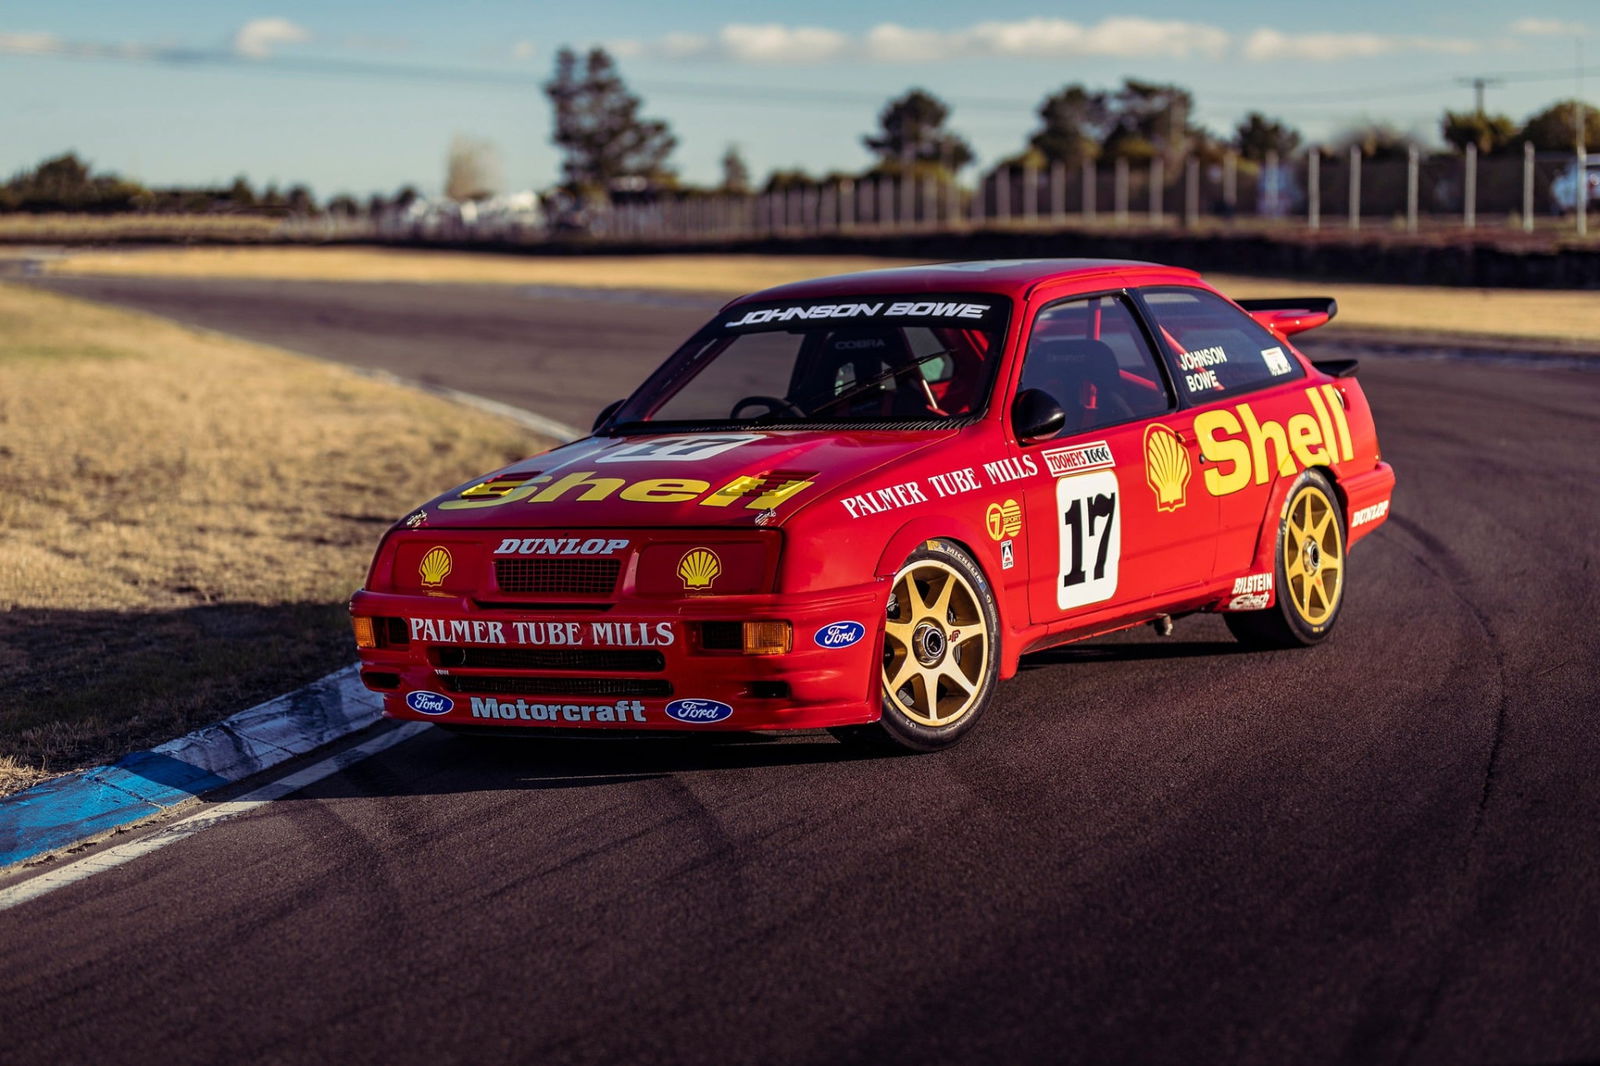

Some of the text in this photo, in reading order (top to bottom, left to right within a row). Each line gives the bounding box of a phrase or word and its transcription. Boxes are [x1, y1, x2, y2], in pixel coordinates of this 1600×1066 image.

[725, 301, 991, 328] JOHNSON BOWE
[834, 339, 886, 350] COBRA
[1180, 346, 1228, 371] JOHNSON
[1185, 370, 1220, 392] BOWE
[612, 438, 754, 458] 17
[1193, 384, 1354, 497] Shell
[1047, 451, 1087, 470] TOOHEYS
[437, 471, 815, 511] Shell
[840, 454, 1038, 519] PALMER TUBE MILLS
[1351, 499, 1389, 528] DUNLOP
[494, 538, 630, 556] DUNLOP
[1063, 492, 1116, 588] 17
[946, 546, 984, 584] MICHELIN
[1231, 572, 1273, 595] BILSTEIN
[410, 617, 675, 647] PALMER TUBE MILLS
[824, 624, 856, 645] Ford
[414, 693, 444, 711] Ford
[470, 697, 646, 723] Motorcraft
[678, 701, 719, 719] Ford
